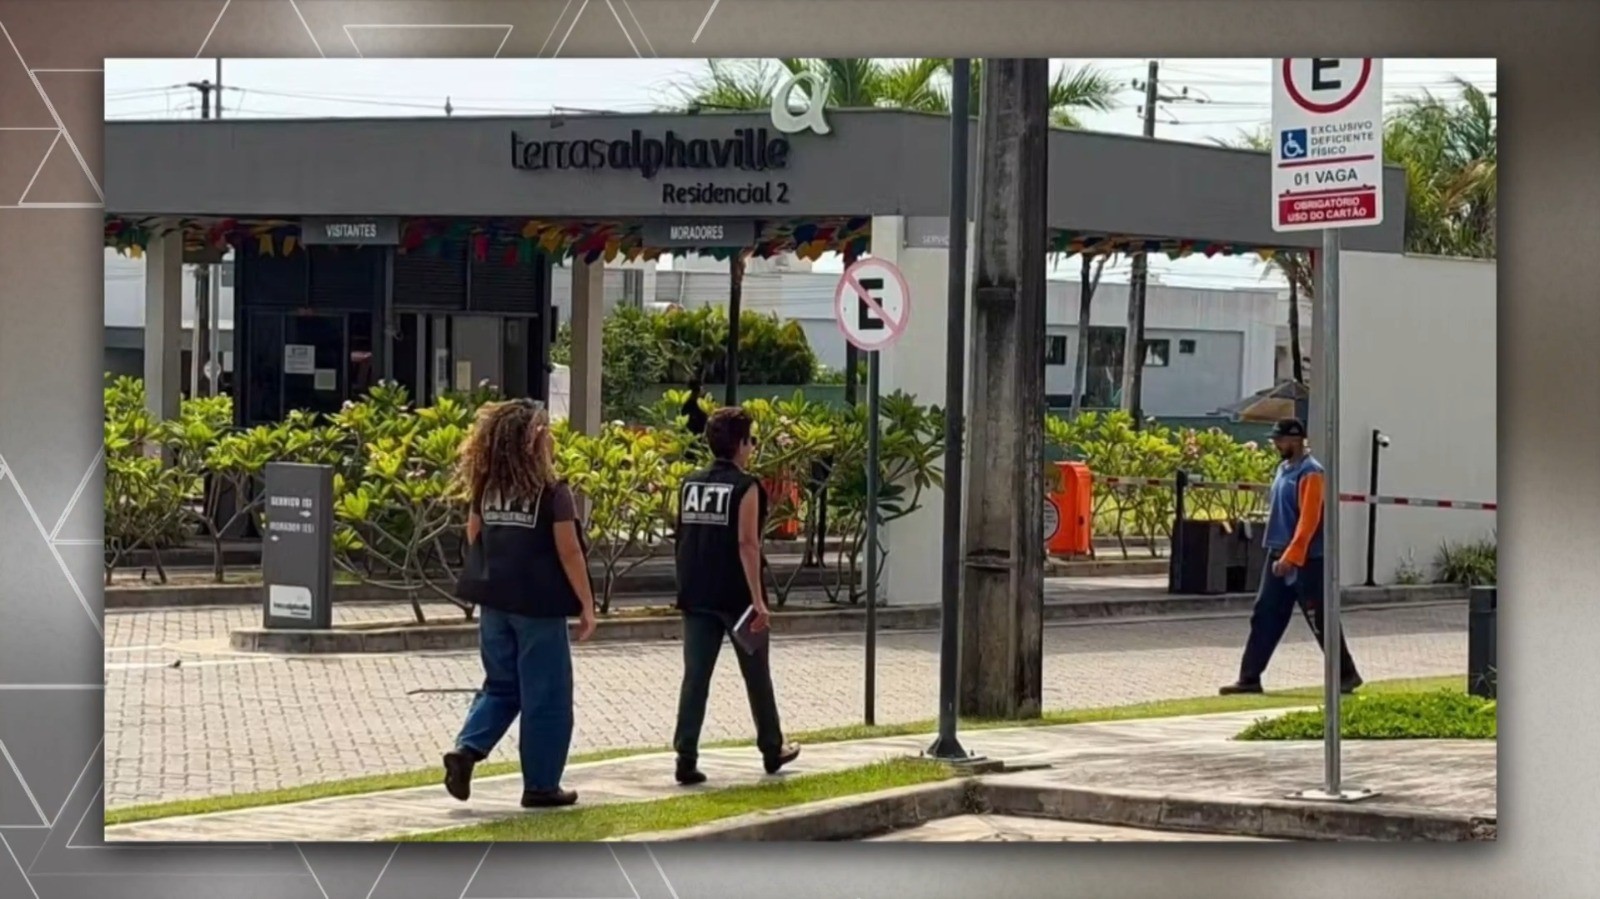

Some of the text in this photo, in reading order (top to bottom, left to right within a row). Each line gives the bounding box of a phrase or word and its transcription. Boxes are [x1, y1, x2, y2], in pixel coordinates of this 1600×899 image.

[1312, 58, 1341, 91] E
[1311, 121, 1373, 134] EXCLUSIVO
[1311, 132, 1374, 146] DEFICIENTE
[1311, 146, 1347, 156] FÍSICO
[1294, 168, 1358, 186] 01 VAGA
[662, 182, 789, 205] Residencial 2
[1293, 197, 1361, 211] OBRIGATÓRIO
[1287, 206, 1367, 222] USO DO CARTÃO
[325, 223, 377, 238] VISITANTES
[670, 225, 724, 240] MORADORES
[859, 278, 884, 330] E
[684, 485, 730, 513] AFT
